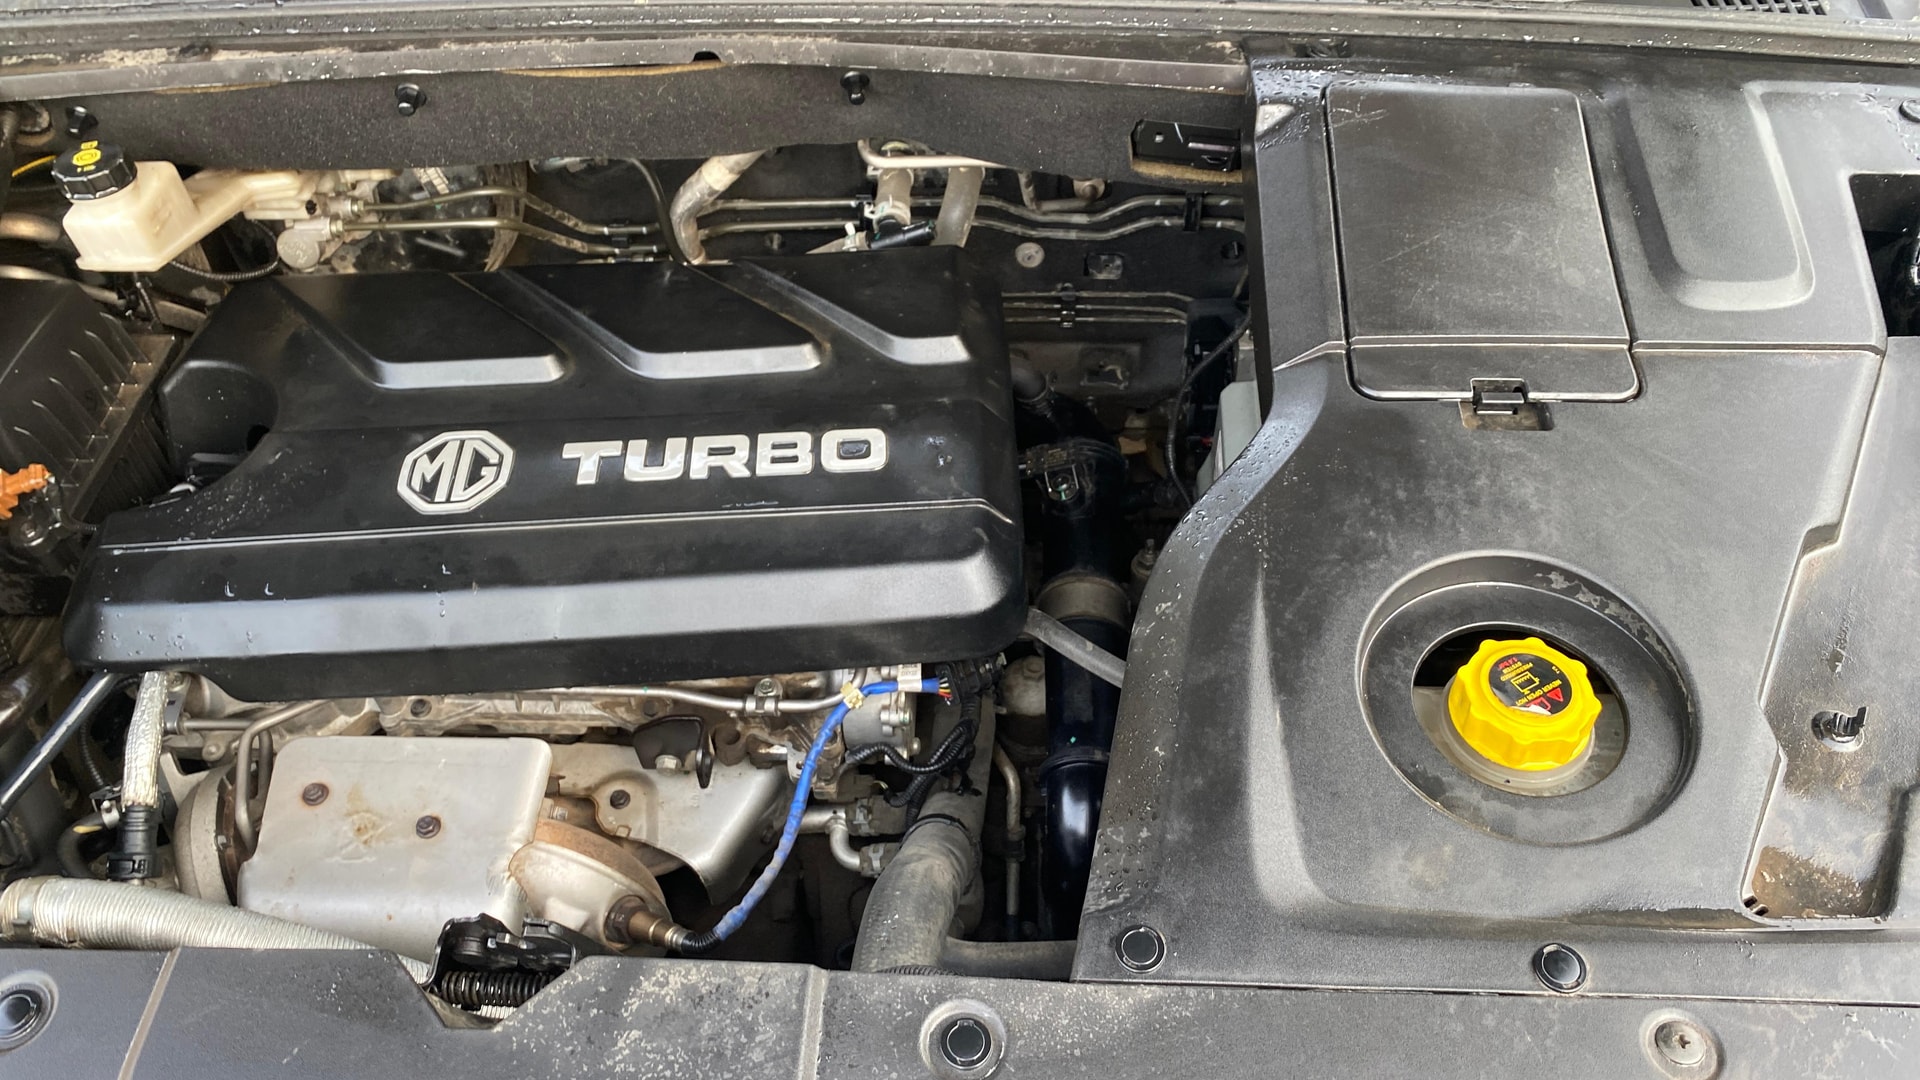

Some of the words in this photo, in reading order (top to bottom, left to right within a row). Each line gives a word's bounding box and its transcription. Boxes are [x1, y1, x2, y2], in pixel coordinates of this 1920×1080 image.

[411, 437, 500, 503] MG
[562, 427, 889, 486] TURBO
[1542, 679, 1562, 693] NEVER
[1515, 696, 1529, 706] HOT
[1527, 689, 1543, 701] OPEN
